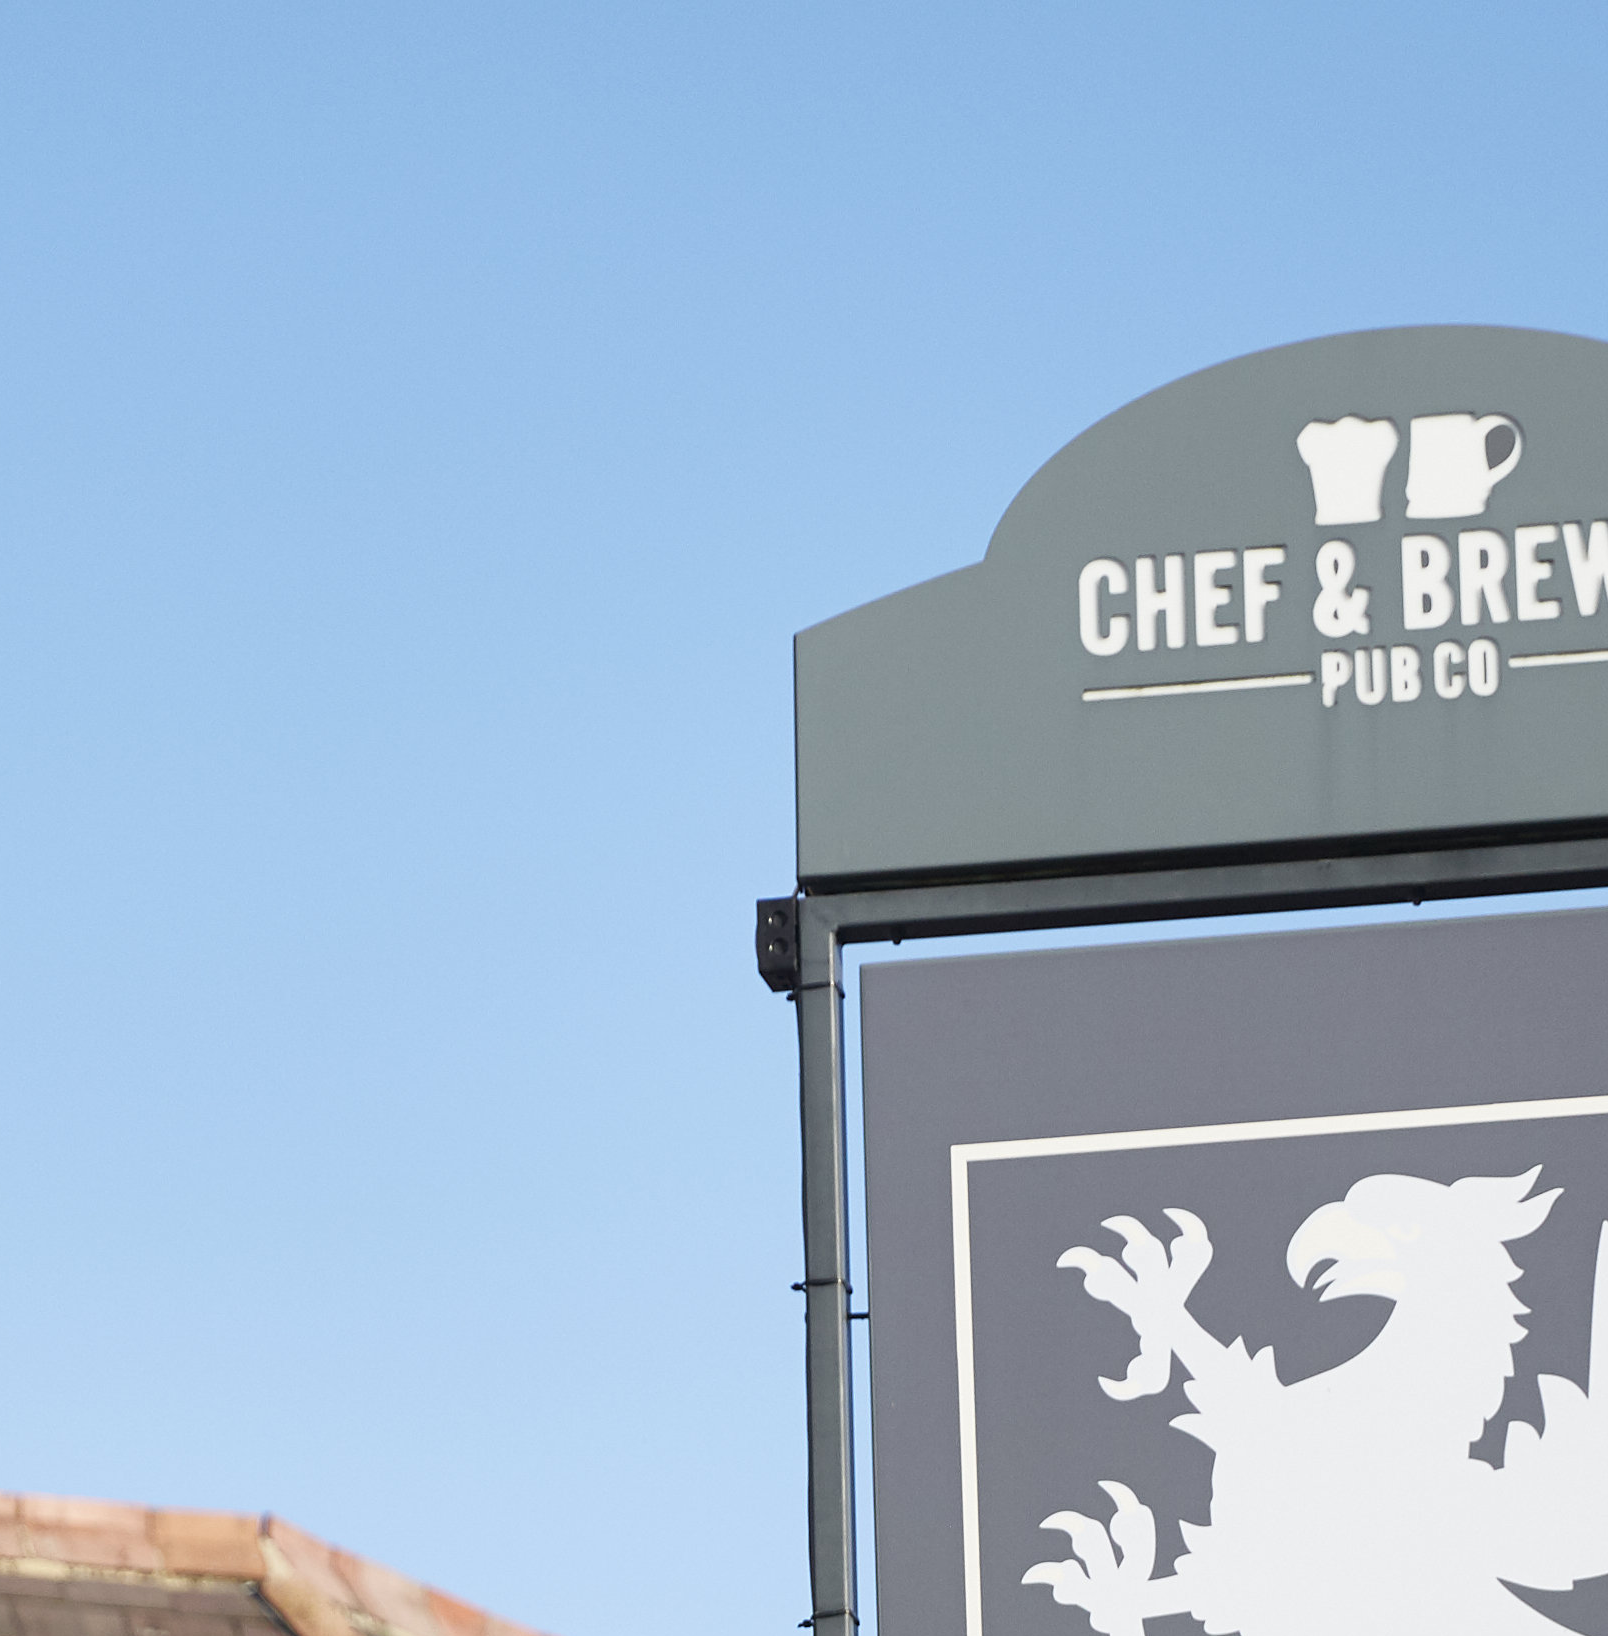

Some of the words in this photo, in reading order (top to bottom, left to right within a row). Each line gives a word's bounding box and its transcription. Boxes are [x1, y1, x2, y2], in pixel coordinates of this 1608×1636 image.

[1077, 547, 1286, 658] CHEF
[1311, 539, 1371, 639] &
[1319, 645, 1423, 709] PUB
[1432, 638, 1500, 700] CO
